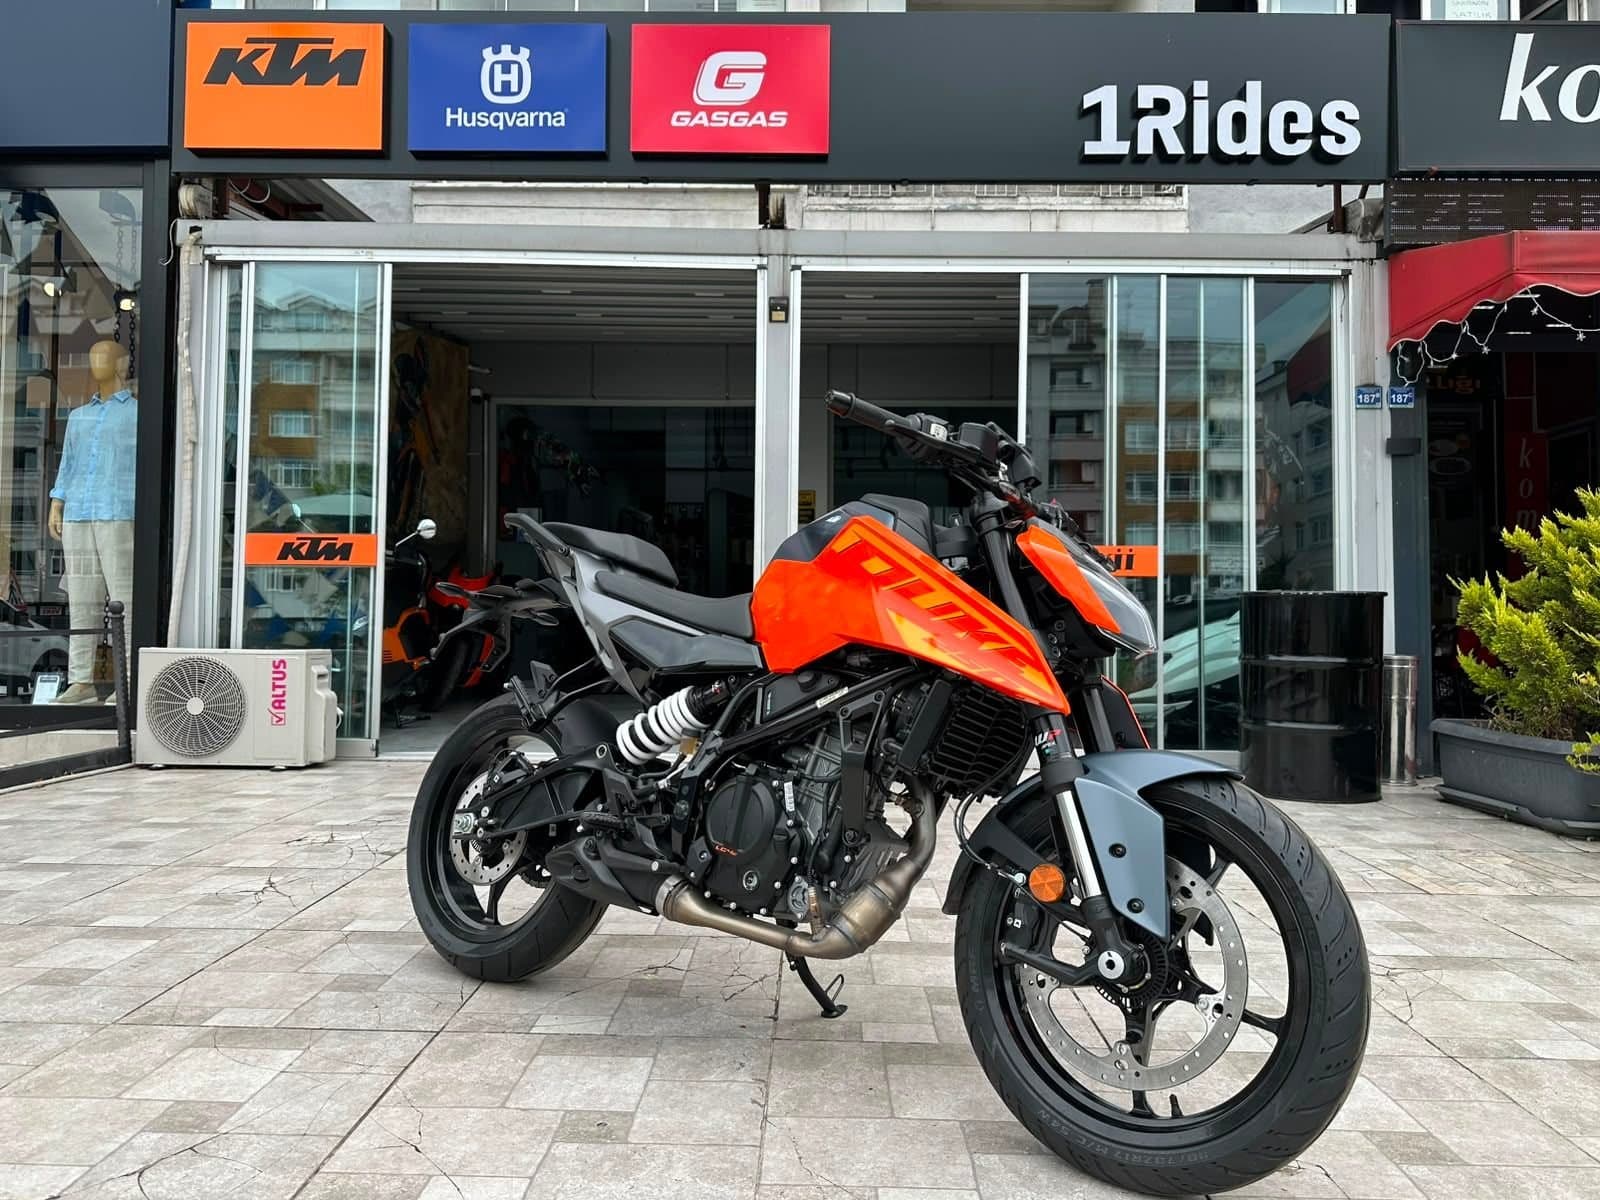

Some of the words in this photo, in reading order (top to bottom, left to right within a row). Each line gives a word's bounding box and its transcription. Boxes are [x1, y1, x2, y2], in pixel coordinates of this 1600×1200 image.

[204, 37, 366, 86] KTM
[446, 107, 566, 130] Husqvarna
[670, 110, 788, 128] GASGAS
[1083, 80, 1362, 156] 1Rides
[277, 536, 354, 562] KTM
[271, 658, 288, 711] ALTUS
